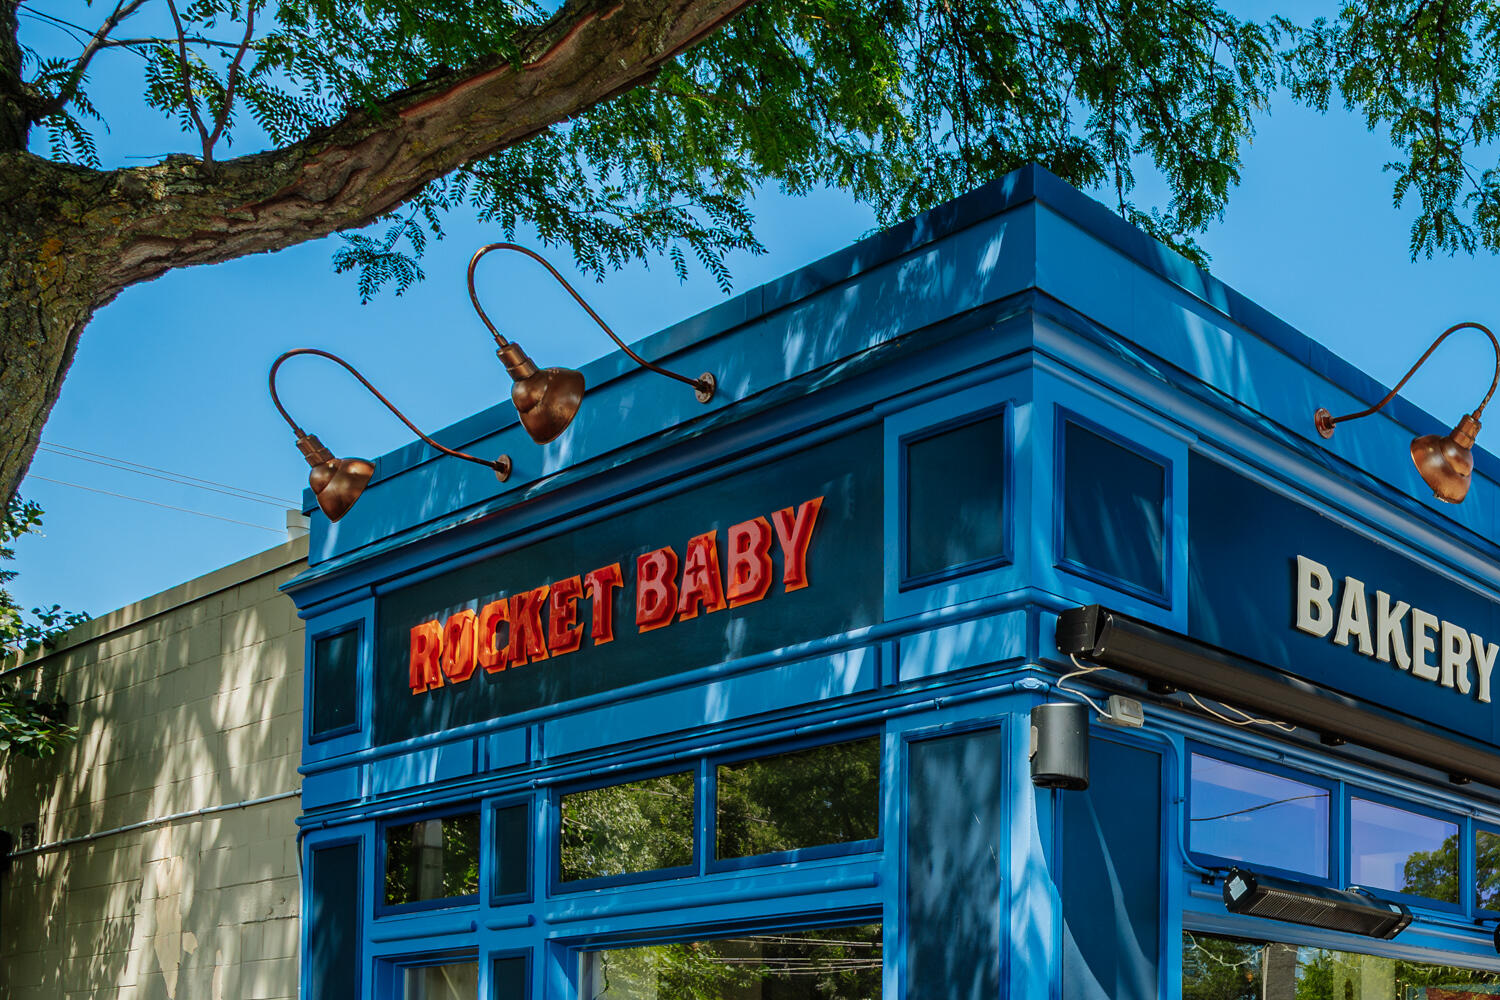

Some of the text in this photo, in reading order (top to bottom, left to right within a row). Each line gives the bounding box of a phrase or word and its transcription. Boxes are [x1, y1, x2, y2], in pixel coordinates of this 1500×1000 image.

[408, 495, 825, 696] ROCKET BABY
[1296, 554, 1500, 703] BAKERY
